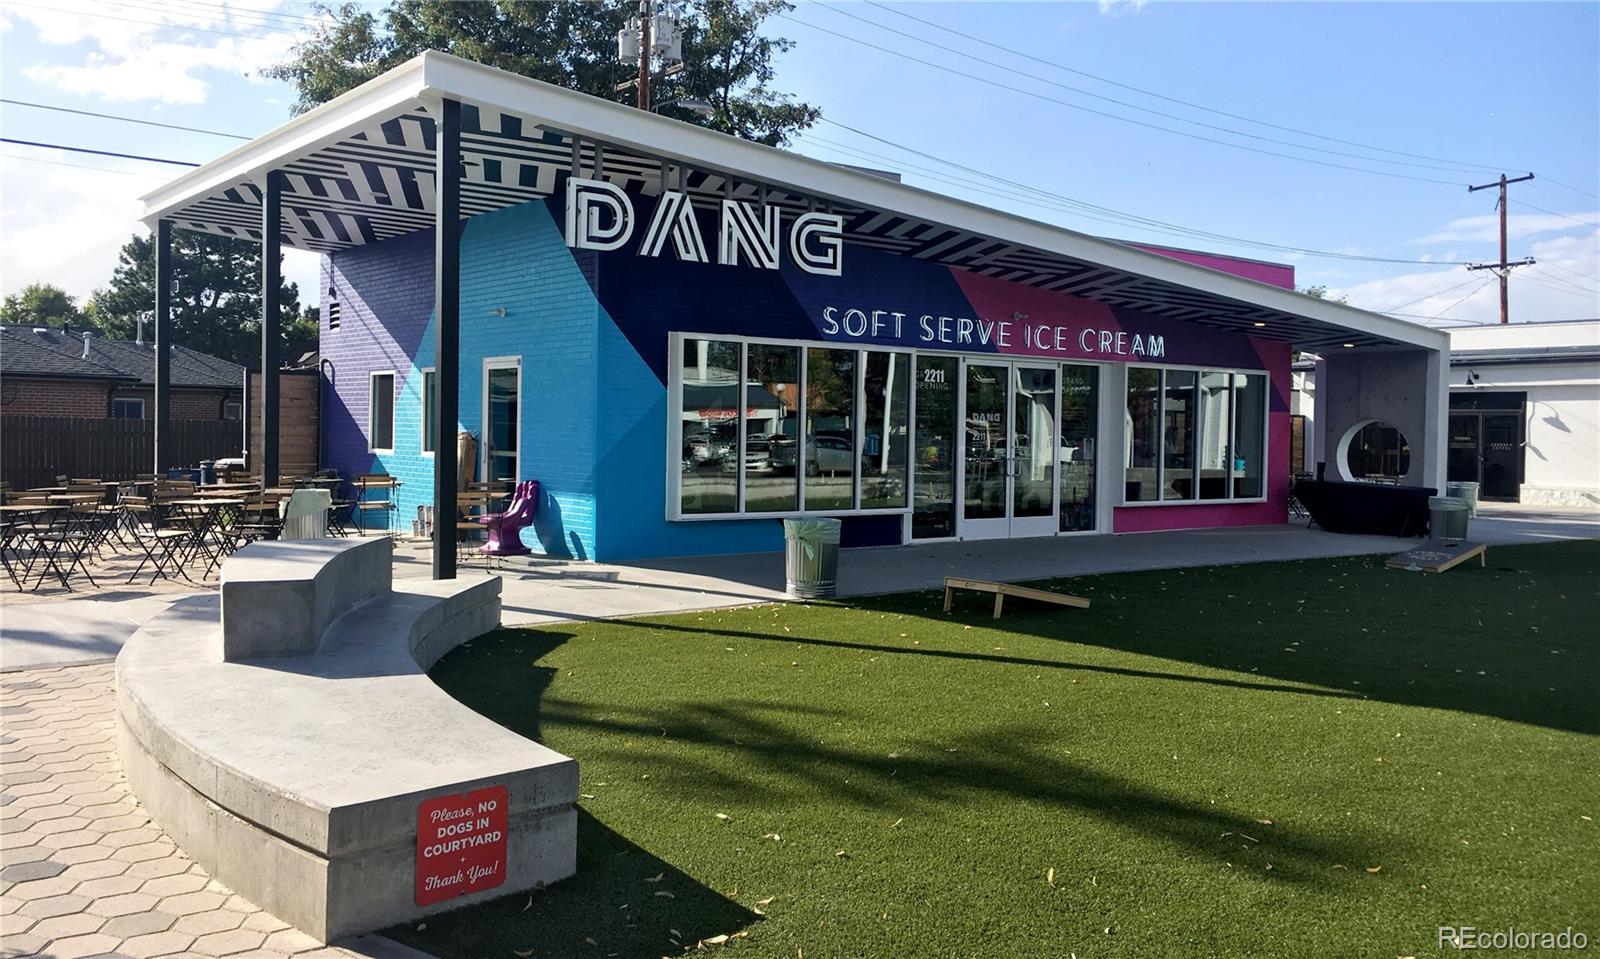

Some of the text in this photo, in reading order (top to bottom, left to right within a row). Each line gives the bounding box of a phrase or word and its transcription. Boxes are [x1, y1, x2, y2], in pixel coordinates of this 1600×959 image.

[565, 177, 843, 277] DANG
[823, 306, 1166, 358] SOFT SERVE ICE CREAM
[924, 369, 945, 383] 2211
[972, 412, 1001, 422] DANG
[431, 801, 496, 823] Please, NO
[438, 817, 489, 838] DOGS IN
[424, 831, 501, 857] COURTYARD
[425, 860, 498, 891] Thank You!
